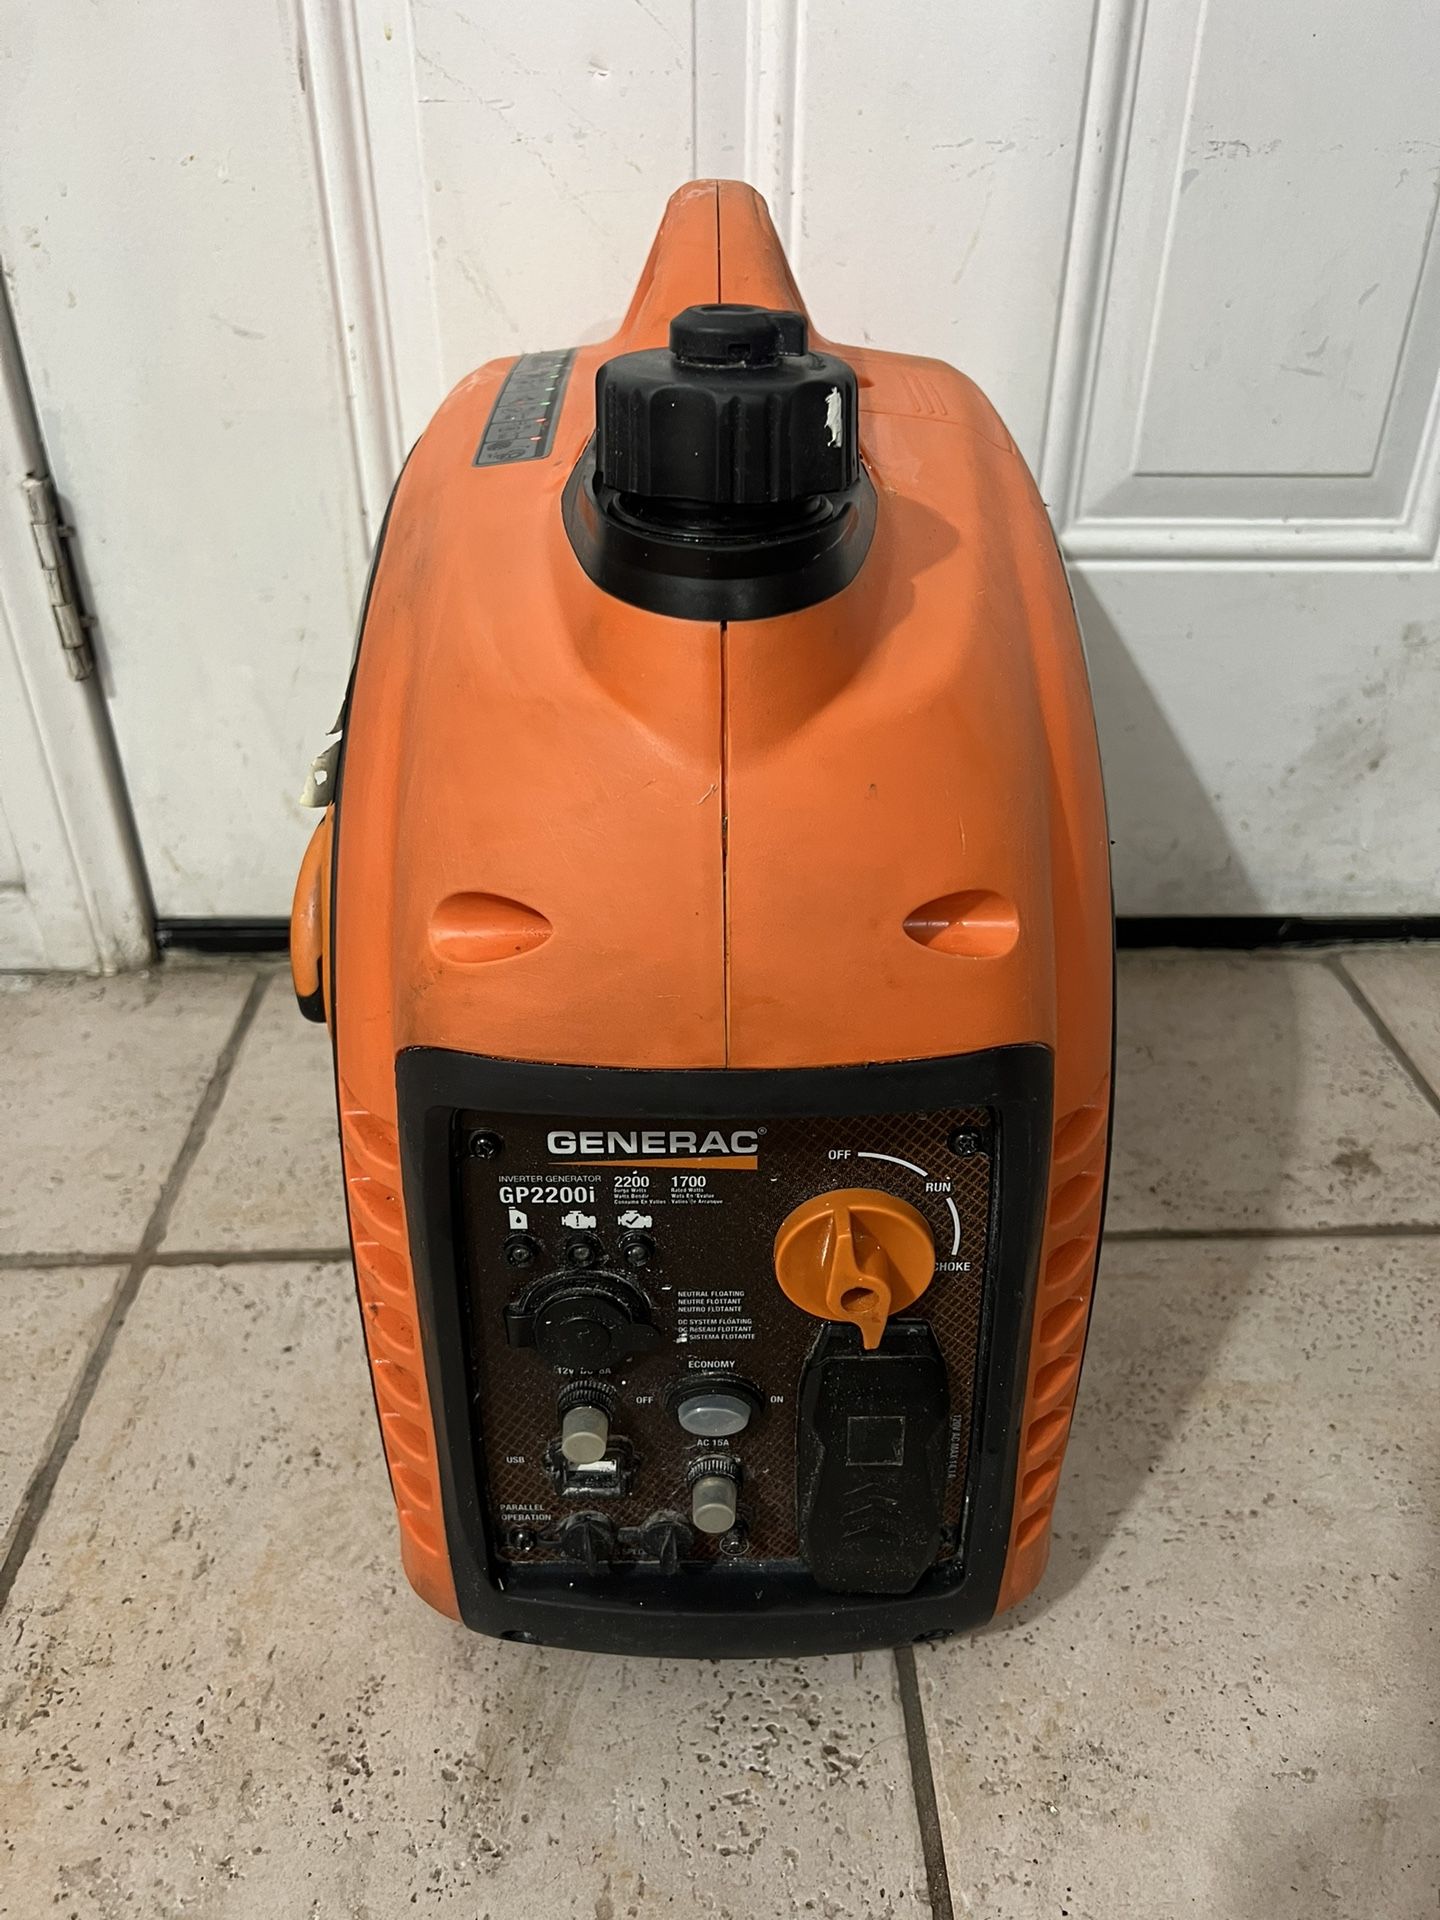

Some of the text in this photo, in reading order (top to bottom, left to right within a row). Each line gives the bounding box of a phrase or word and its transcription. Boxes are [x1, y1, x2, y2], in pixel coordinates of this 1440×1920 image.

[547, 1130, 759, 1155] GENERAC
[828, 1150, 851, 1160] OFF
[498, 1175, 602, 1183] INVERTER GENERATOR
[613, 1175, 650, 1188] 2200
[671, 1175, 707, 1188] 1700
[925, 1182, 951, 1193] RUN
[499, 1186, 596, 1204] GP2200i
[688, 1360, 736, 1369] ECONOMY
[636, 1396, 654, 1404] OFF
[770, 1395, 784, 1404] ON
[696, 1438, 730, 1447] AC 15A
[506, 1456, 525, 1464] USB
[501, 1513, 552, 1521] OPERATION
